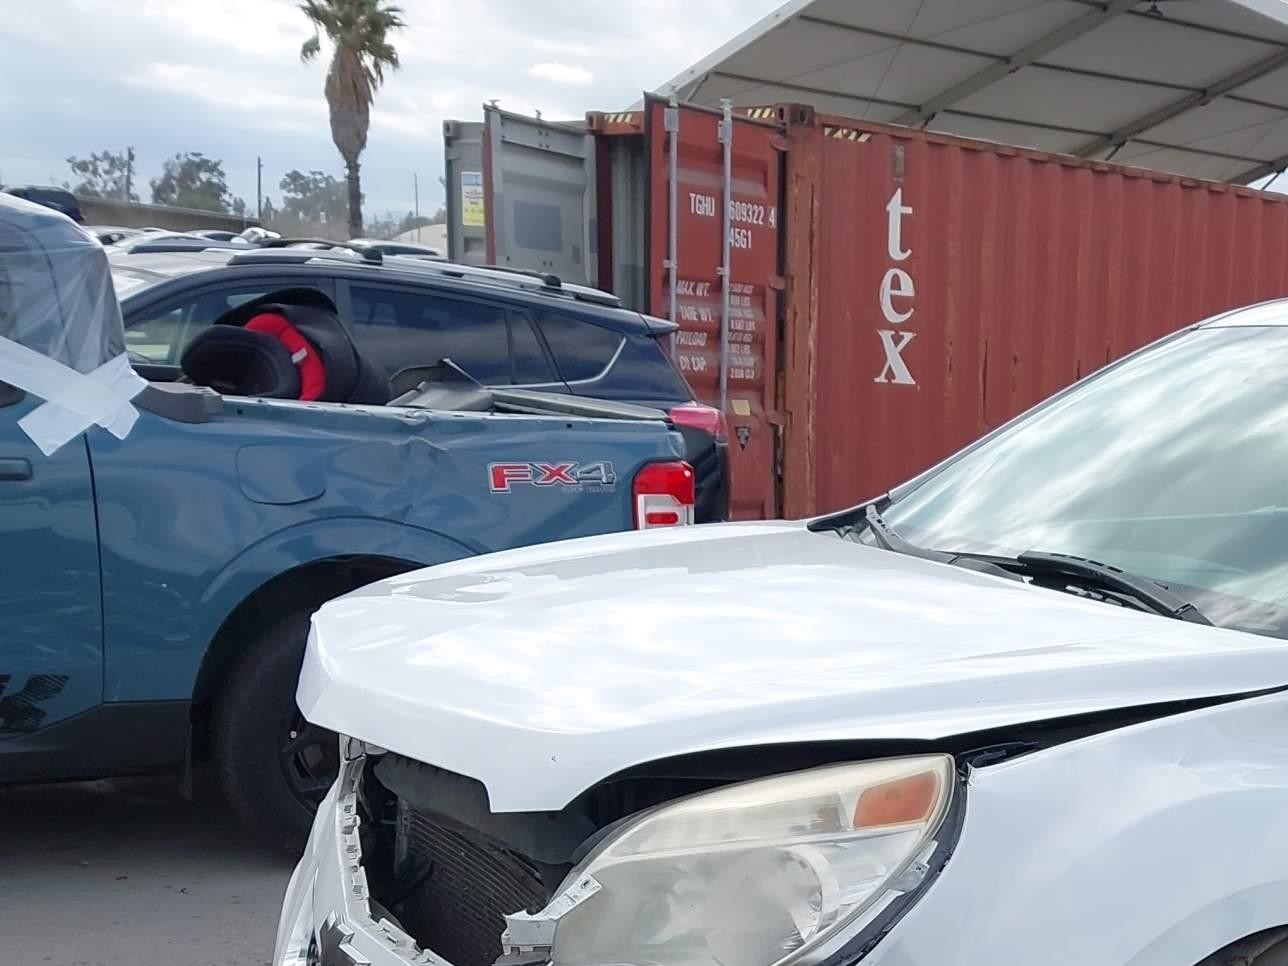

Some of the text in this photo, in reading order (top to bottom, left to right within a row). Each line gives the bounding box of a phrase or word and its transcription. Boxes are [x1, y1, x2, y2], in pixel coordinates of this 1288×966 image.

[689, 192, 777, 229] TGHU 609322 4
[729, 227, 752, 249] 45G1
[874, 187, 917, 385] tex
[489, 461, 617, 494] FX4
